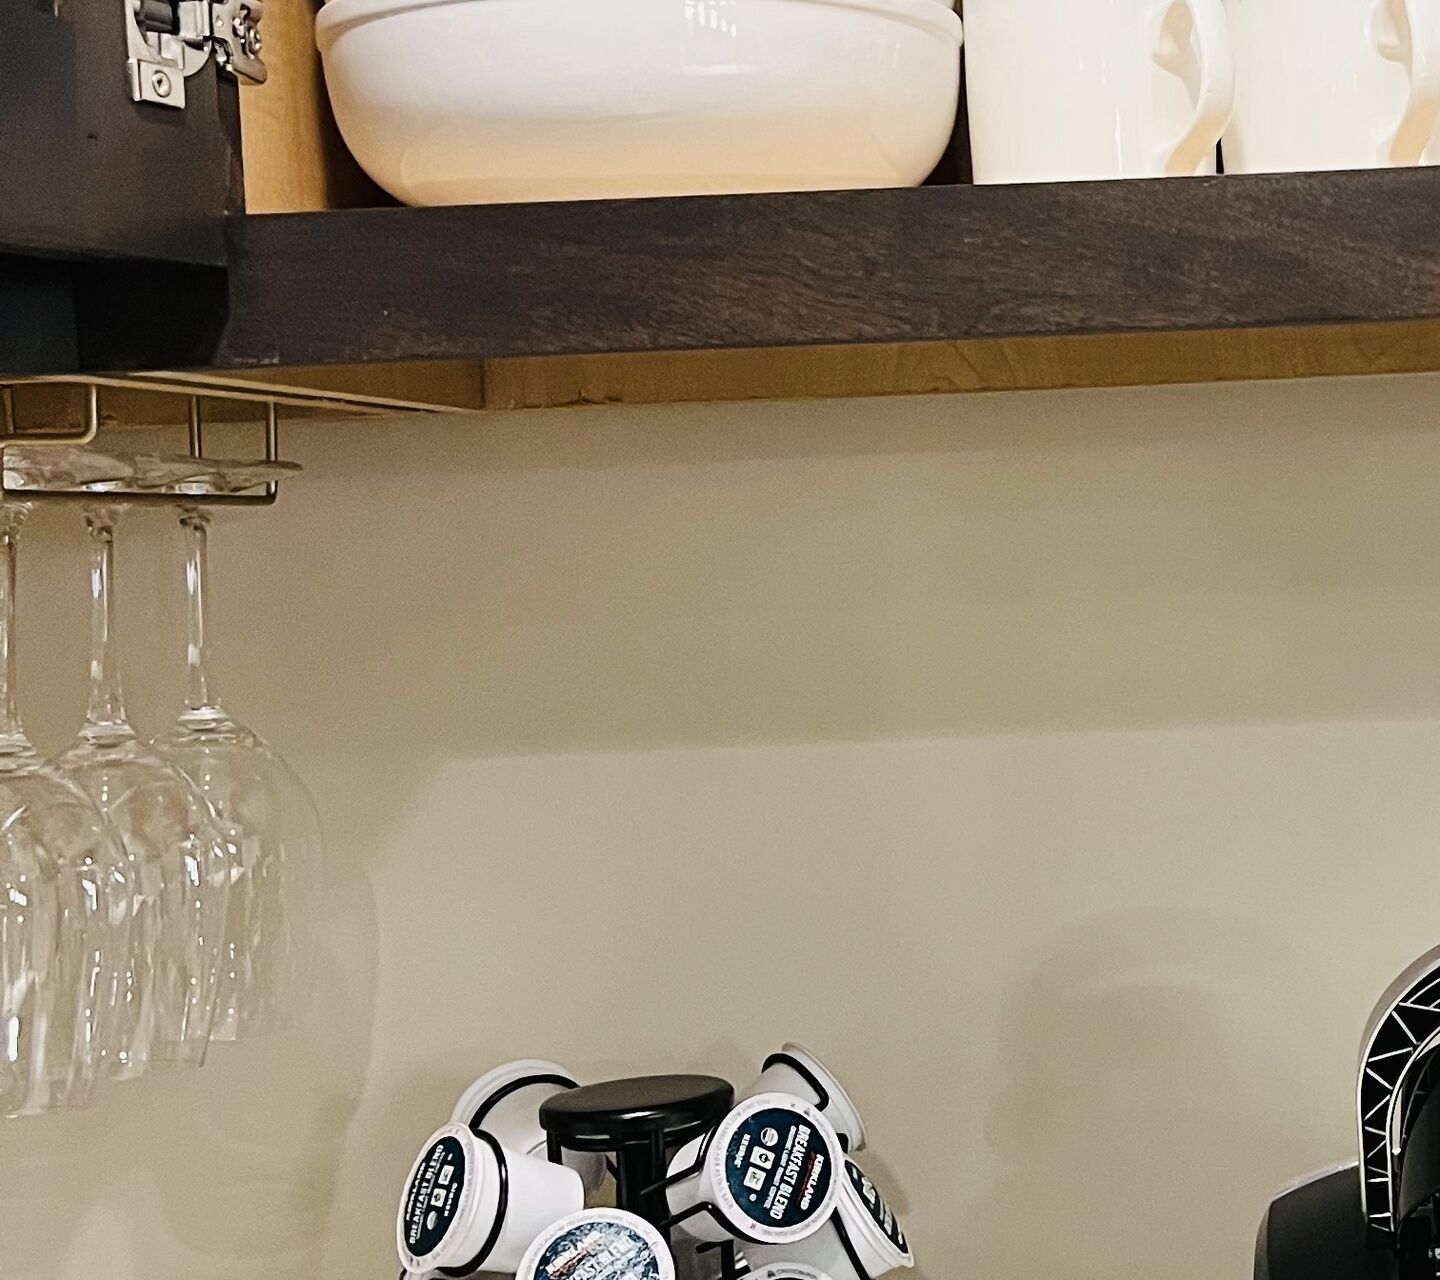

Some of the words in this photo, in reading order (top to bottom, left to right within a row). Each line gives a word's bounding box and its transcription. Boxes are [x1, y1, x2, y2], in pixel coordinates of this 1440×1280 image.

[781, 1123, 812, 1185] BREAKFAST
[798, 1152, 825, 1211] KIRKLAND
[768, 1182, 793, 1220] BLEND
